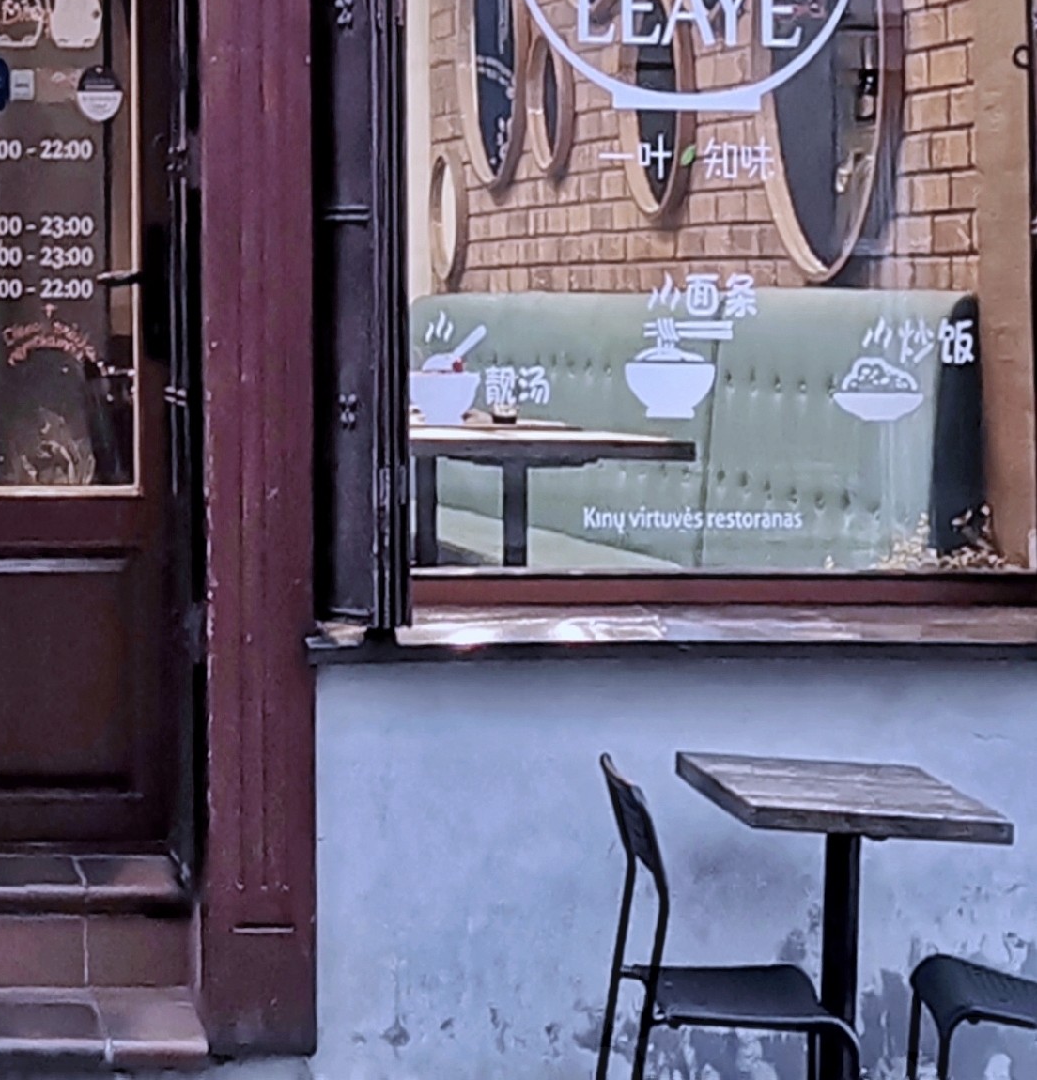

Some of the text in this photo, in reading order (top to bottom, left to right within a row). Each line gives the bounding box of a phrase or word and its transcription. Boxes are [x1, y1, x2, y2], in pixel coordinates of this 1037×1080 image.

[40, 139, 94, 160] 22:00
[598, 133, 775, 182] 一叶 知味
[40, 215, 94, 239] 23:00
[40, 246, 94, 270] 23:00
[40, 279, 94, 300] 22:00
[685, 273, 758, 317] 面条
[898, 315, 975, 364] 炒饭
[485, 366, 550, 405] 靓汤
[583, 506, 803, 533] Kinų virtuvės restoranas
